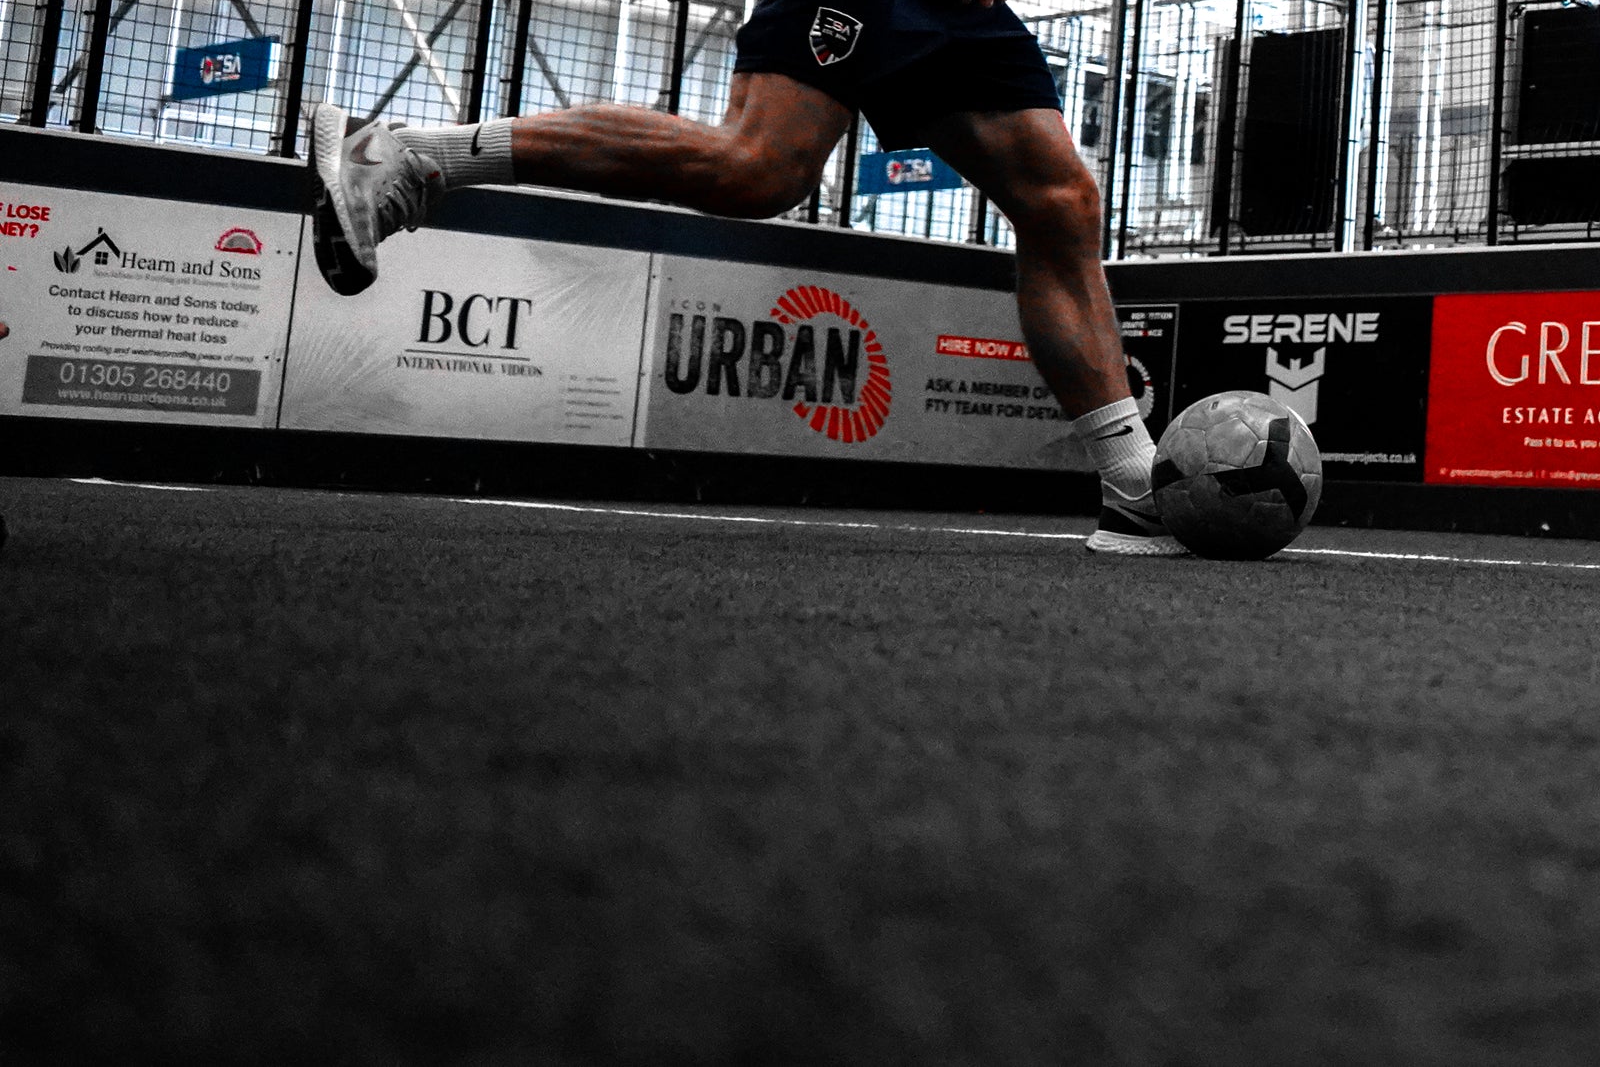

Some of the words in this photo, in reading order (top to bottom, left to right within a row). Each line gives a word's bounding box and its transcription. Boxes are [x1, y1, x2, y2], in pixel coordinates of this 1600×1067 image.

[7, 203, 51, 222] LOSE
[121, 251, 176, 273] Hearn
[181, 260, 214, 276] and
[219, 261, 261, 281] Sons
[48, 284, 105, 301] Contact
[109, 289, 151, 305] Hearn
[154, 295, 180, 307] and
[183, 295, 217, 310] Sons
[221, 299, 260, 315] today,
[670, 299, 721, 312] ICON
[68, 304, 82, 316] to
[86, 305, 139, 321] discuss
[143, 310, 172, 324] how
[176, 313, 190, 325] to
[193, 315, 239, 328] reduce
[416, 289, 532, 350] BCT
[75, 324, 107, 336] your
[111, 325, 163, 340] thermal
[167, 328, 196, 342] heat
[200, 330, 227, 344] loss
[1222, 312, 1381, 344] SERENE
[938, 338, 972, 354] HIRE
[974, 341, 1010, 356] NOW
[396, 355, 495, 375] INTERNATIONAL
[501, 363, 543, 377] VIDEOS
[665, 313, 860, 404] URBAN
[59, 362, 136, 387] 01305
[143, 366, 231, 393] 268440
[925, 378, 952, 393] ASK
[958, 380, 967, 393] A
[971, 380, 1030, 398] MEMBER
[925, 398, 951, 413] FTY
[955, 399, 992, 416] TEAM
[997, 403, 1023, 418] FOR
[1502, 407, 1574, 424] ESTATE
